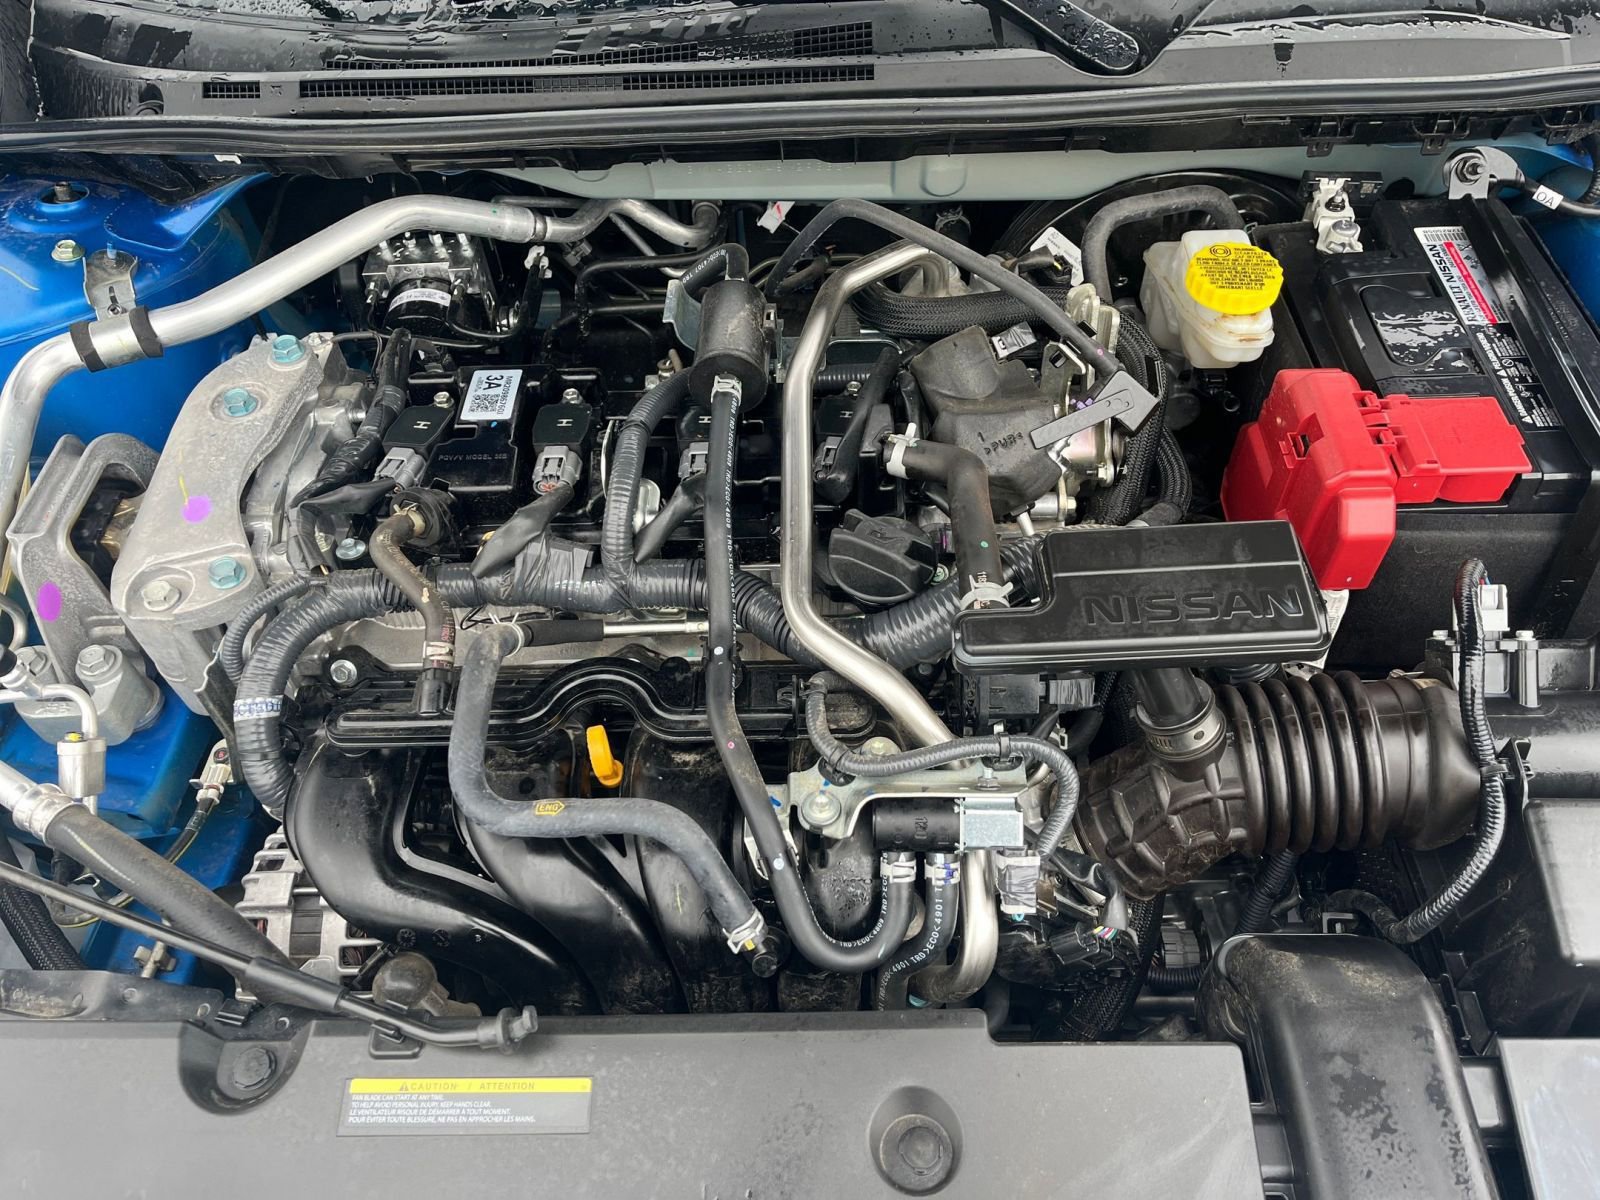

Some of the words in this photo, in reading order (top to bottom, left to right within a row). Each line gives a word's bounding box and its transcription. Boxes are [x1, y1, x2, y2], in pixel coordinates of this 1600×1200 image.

[1426, 244, 1457, 283] NISSAN
[1449, 284, 1475, 322] RENAULT
[483, 375, 504, 390] 3A
[1086, 585, 1304, 624] NISSAN
[410, 1081, 457, 1091] CAUTION
[479, 1081, 536, 1091] ATTENTION
